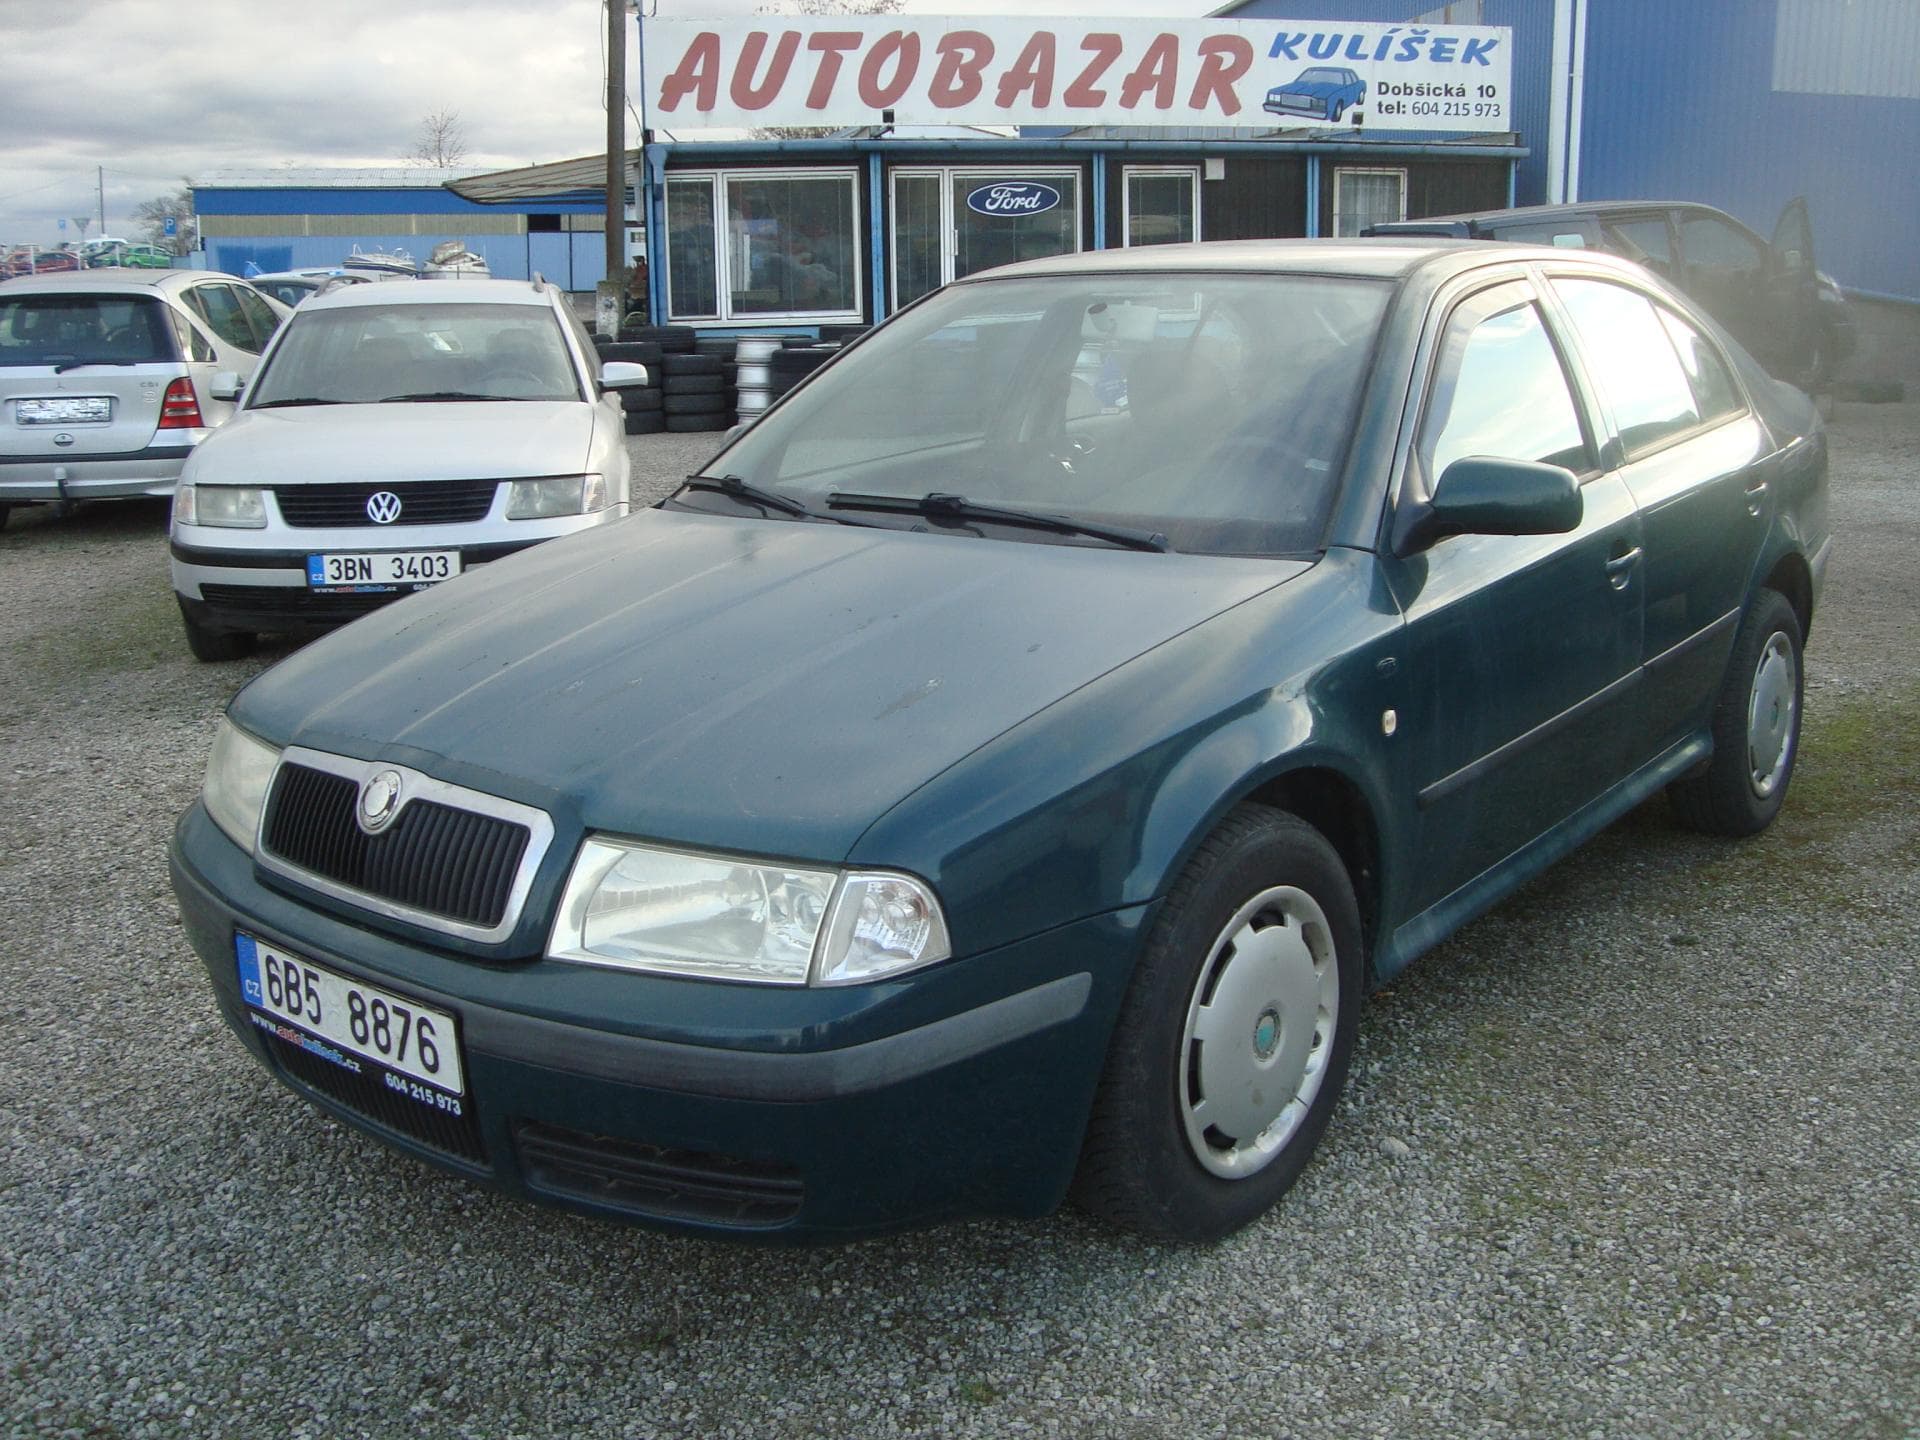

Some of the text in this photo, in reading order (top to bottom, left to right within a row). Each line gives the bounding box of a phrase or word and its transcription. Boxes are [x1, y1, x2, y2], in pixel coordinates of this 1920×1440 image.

[1268, 28, 1500, 67] KULÍŠEK
[657, 30, 1254, 117] AUTOBAZAR
[1377, 81, 1496, 99] Dobšická 10
[1377, 101, 1501, 118] tel: 604 215 973
[985, 186, 1042, 211] Ford
[166, 218, 174, 230] P
[329, 557, 373, 580] 3BN
[391, 556, 449, 579] 3403
[245, 954, 440, 1074] CZ 6B5 8876
[385, 1072, 408, 1094] 604
[410, 1082, 434, 1105] 215
[436, 1093, 462, 1116] 973
